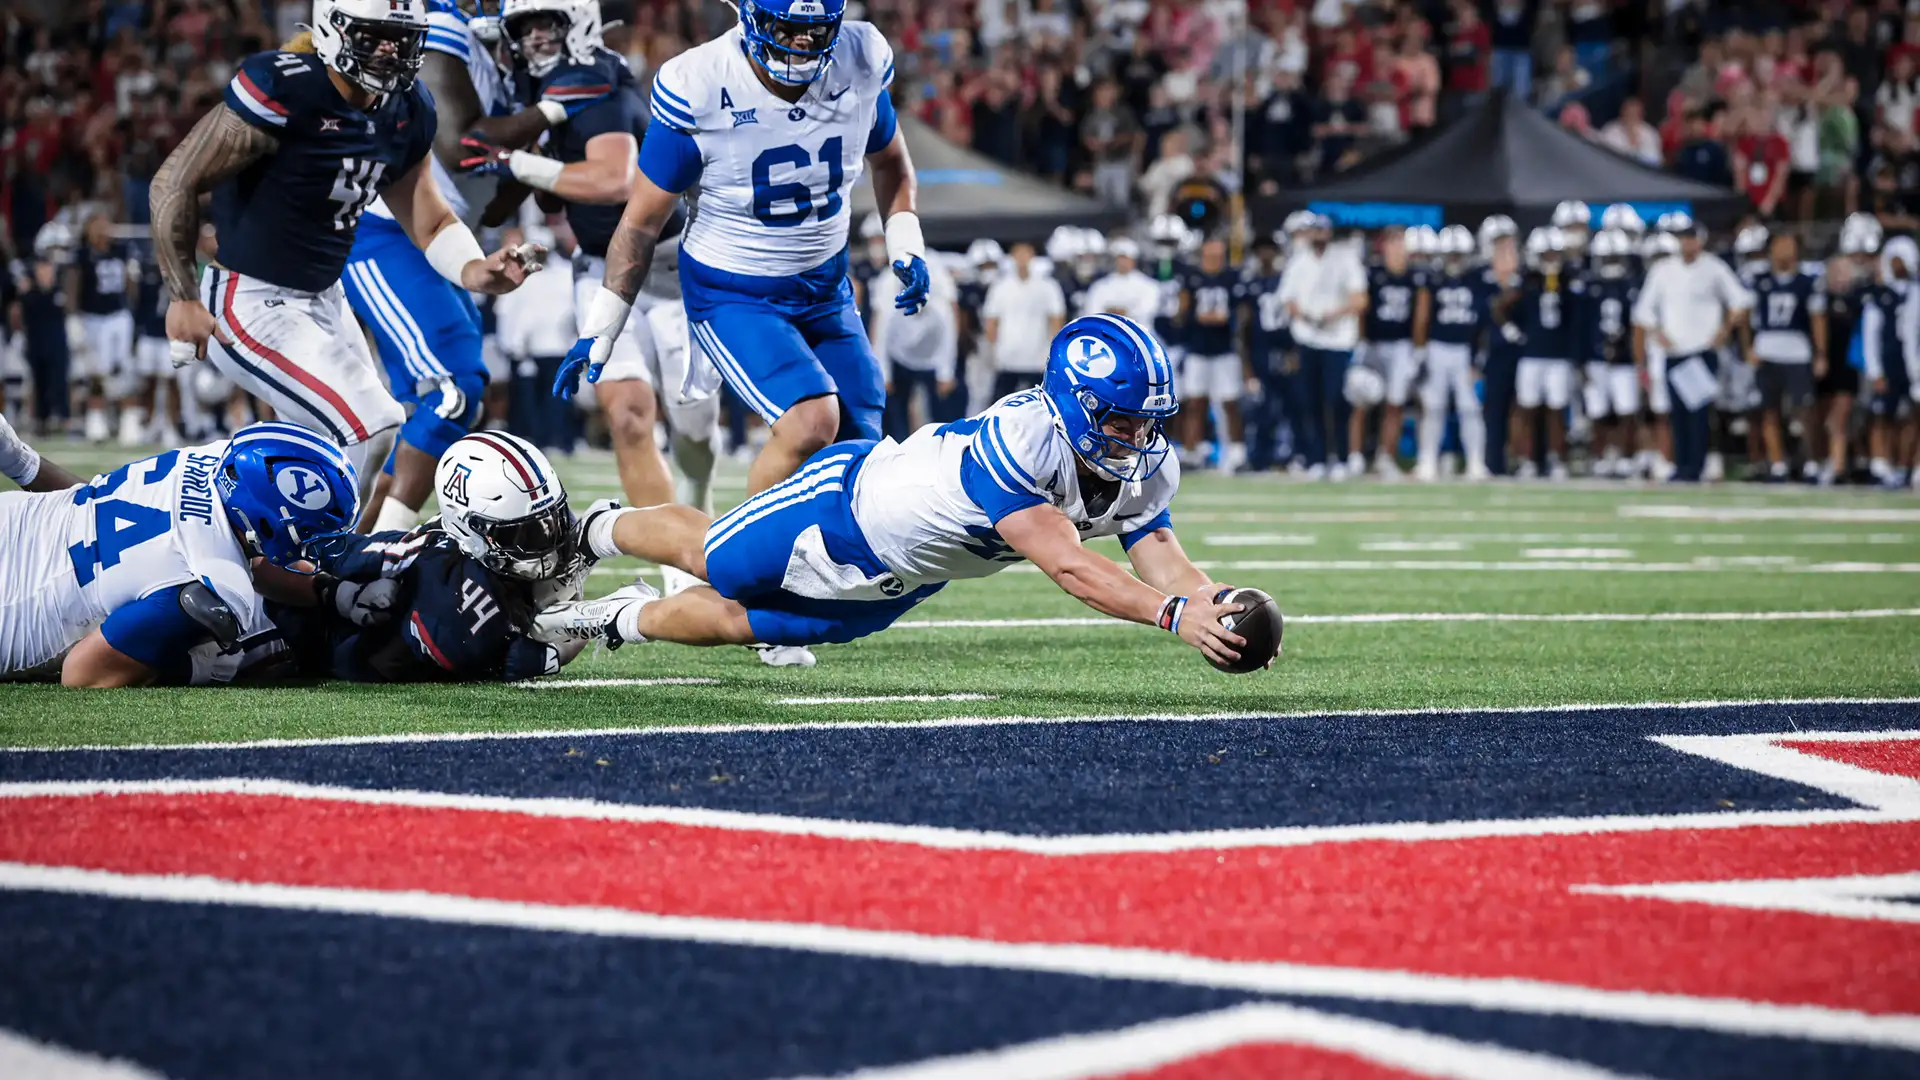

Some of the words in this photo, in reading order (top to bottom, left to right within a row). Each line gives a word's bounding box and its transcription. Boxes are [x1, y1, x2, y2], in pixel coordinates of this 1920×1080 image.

[274, 52, 312, 77] 41
[720, 86, 734, 110] A
[328, 157, 387, 231] 41
[751, 135, 844, 228] 61
[1075, 338, 1111, 373] Y
[288, 468, 326, 505] Y
[443, 463, 472, 507] A
[67, 449, 182, 588] 64
[456, 577, 500, 637] 44
